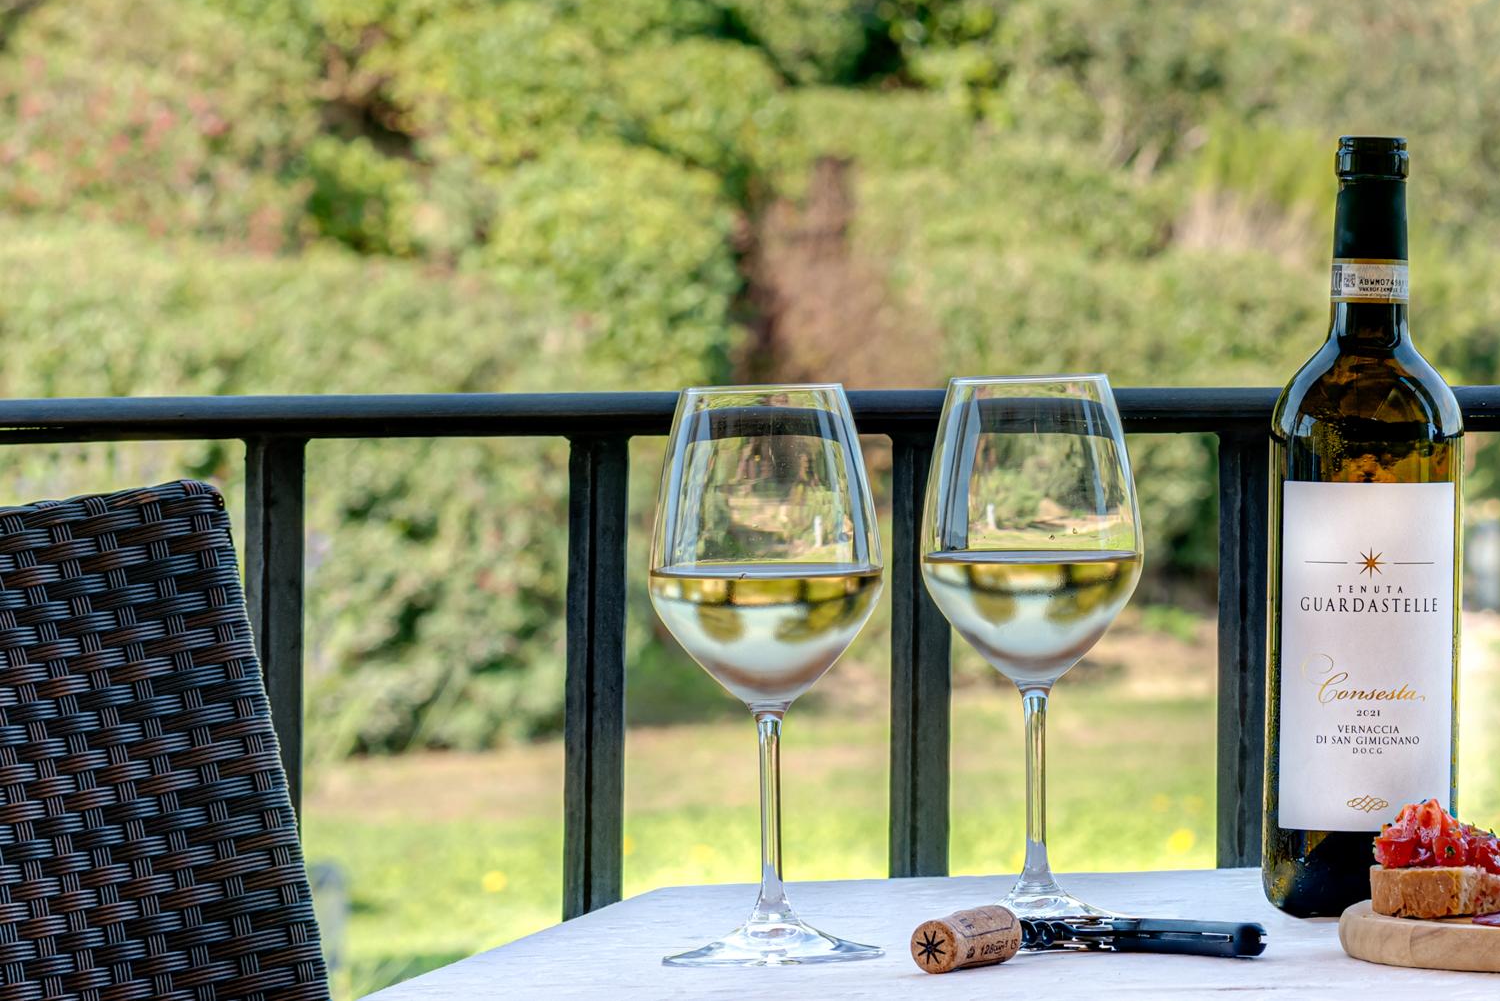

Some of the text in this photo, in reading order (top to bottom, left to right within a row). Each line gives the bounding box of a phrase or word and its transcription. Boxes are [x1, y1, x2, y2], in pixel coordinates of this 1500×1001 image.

[1337, 585, 1404, 594] TENUTA
[1300, 596, 1439, 613] GUARDASTELLE
[1317, 671, 1426, 705] Consesta
[1356, 709, 1381, 717] 2021
[1337, 724, 1400, 734] VERNACCIA
[1316, 735, 1420, 745] DI SAN GIMIGNANO
